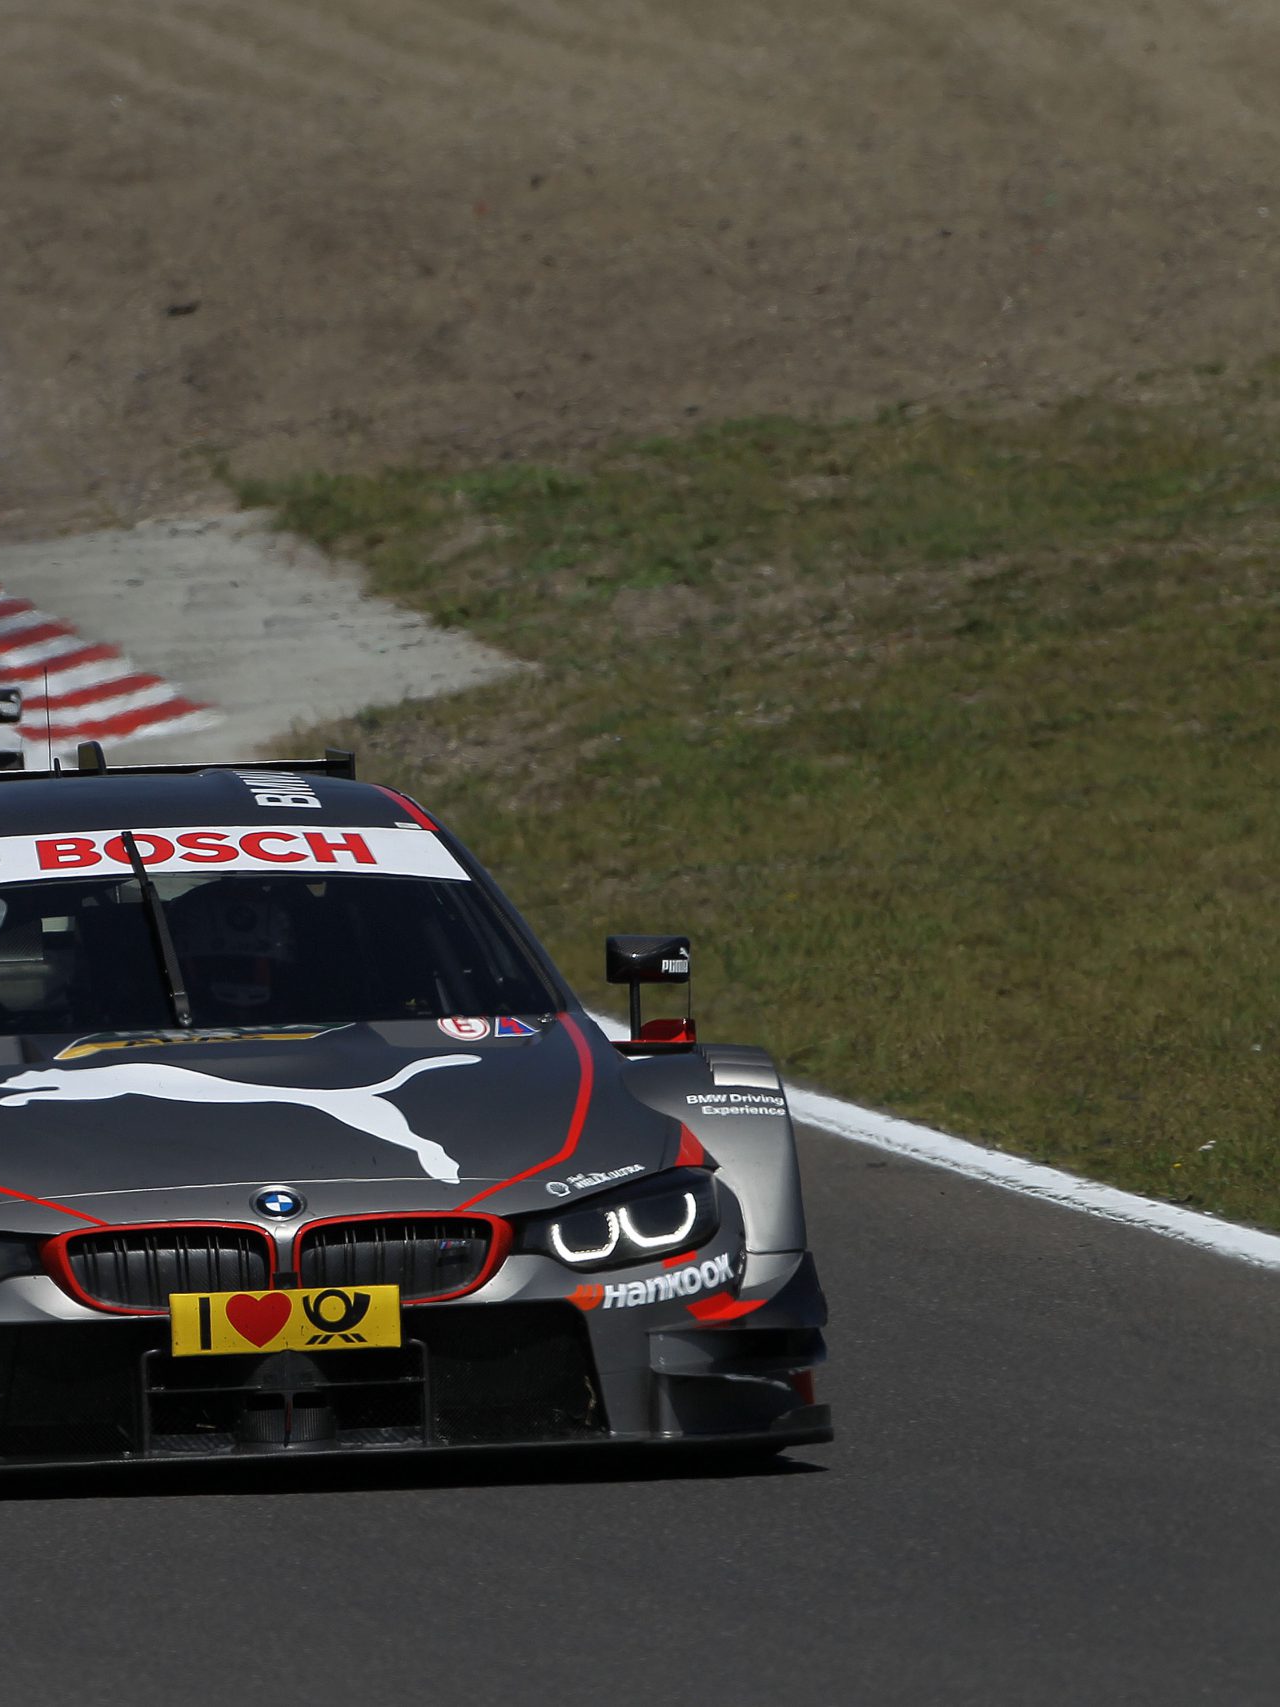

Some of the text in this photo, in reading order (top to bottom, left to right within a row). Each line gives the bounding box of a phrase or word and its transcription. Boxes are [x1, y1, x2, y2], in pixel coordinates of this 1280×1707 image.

[34, 832, 378, 871] BOSCH
[686, 1093, 786, 1107] BMW Driving
[701, 1104, 787, 1117] Experience
[197, 1296, 212, 1351] I
